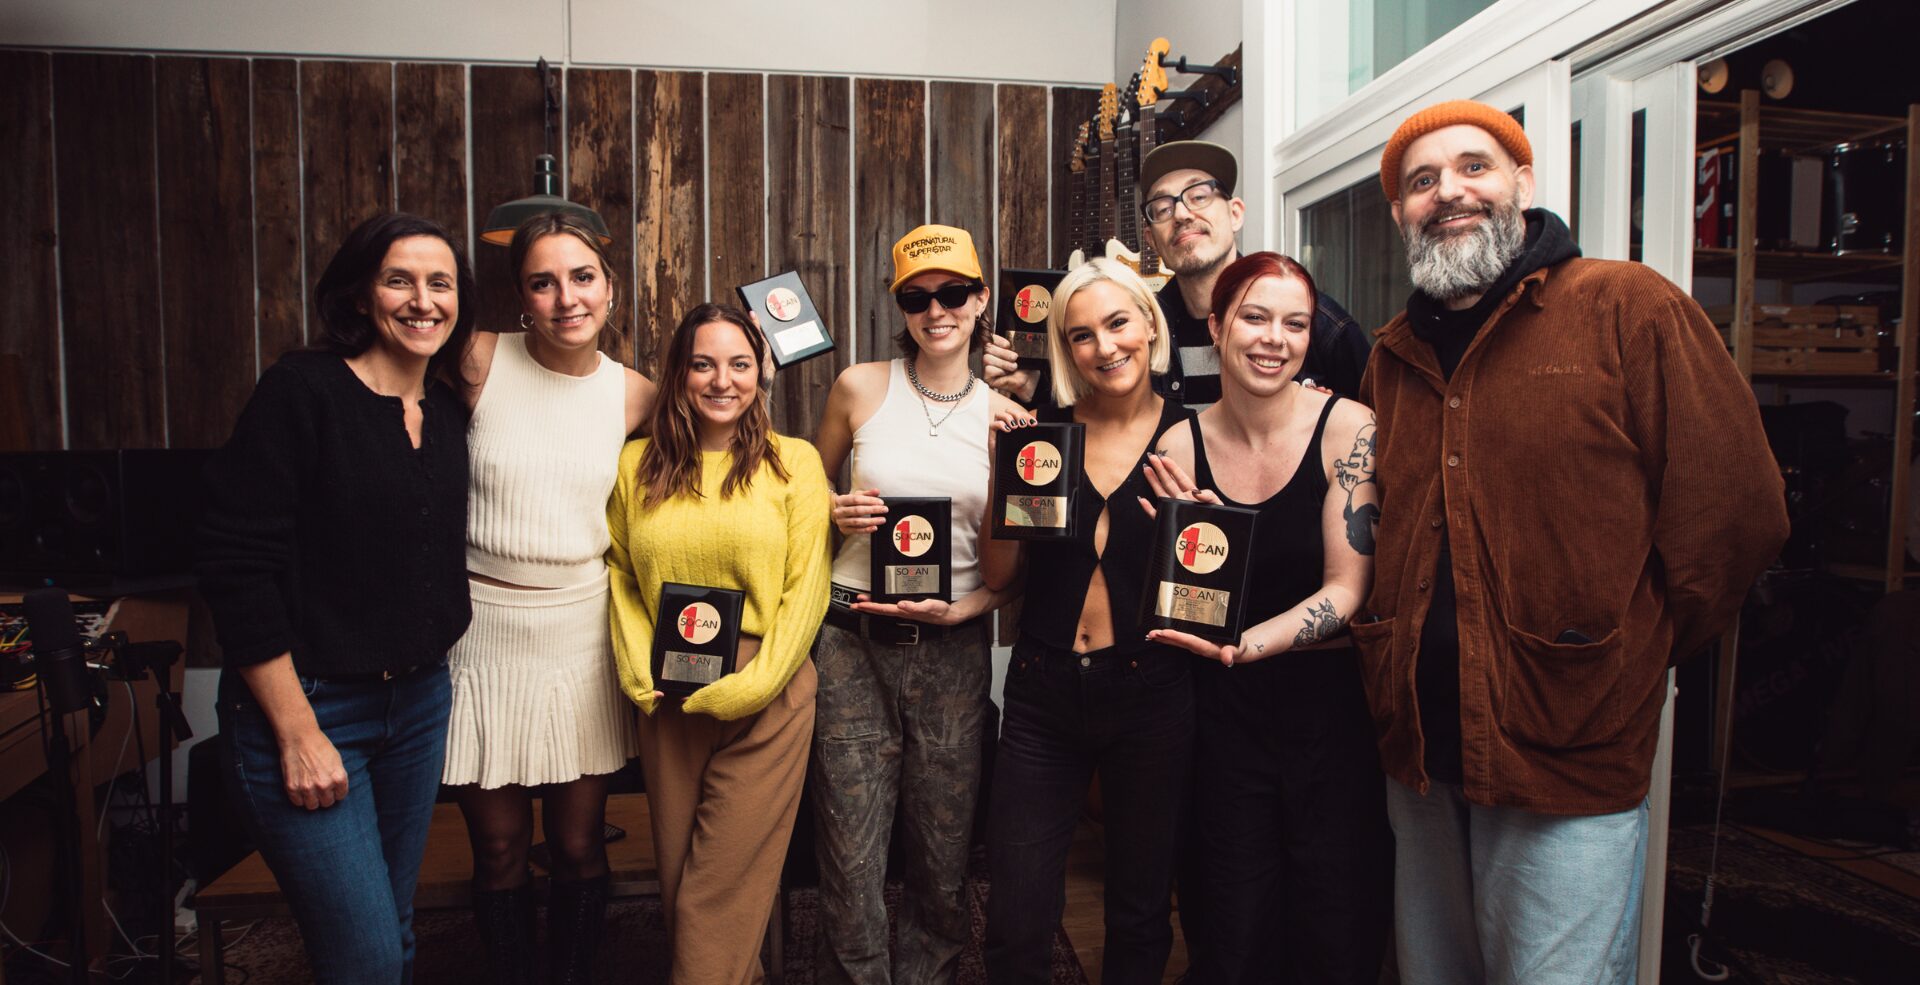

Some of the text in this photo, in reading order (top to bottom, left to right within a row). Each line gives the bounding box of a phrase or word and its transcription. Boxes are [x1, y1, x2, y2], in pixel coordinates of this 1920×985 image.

[902, 236, 957, 252] SUPERNATURAL
[1016, 300, 1050, 309] SOCAN
[1018, 458, 1059, 469] SOCAN
[1018, 497, 1055, 508] SOCAN
[895, 531, 931, 541] SOCAN
[1178, 540, 1225, 556] SOCAN
[895, 567, 929, 576] SOCAN
[1173, 584, 1215, 601] SOCAN
[680, 617, 718, 629] SOCAN
[676, 655, 711, 667] SOCAN
